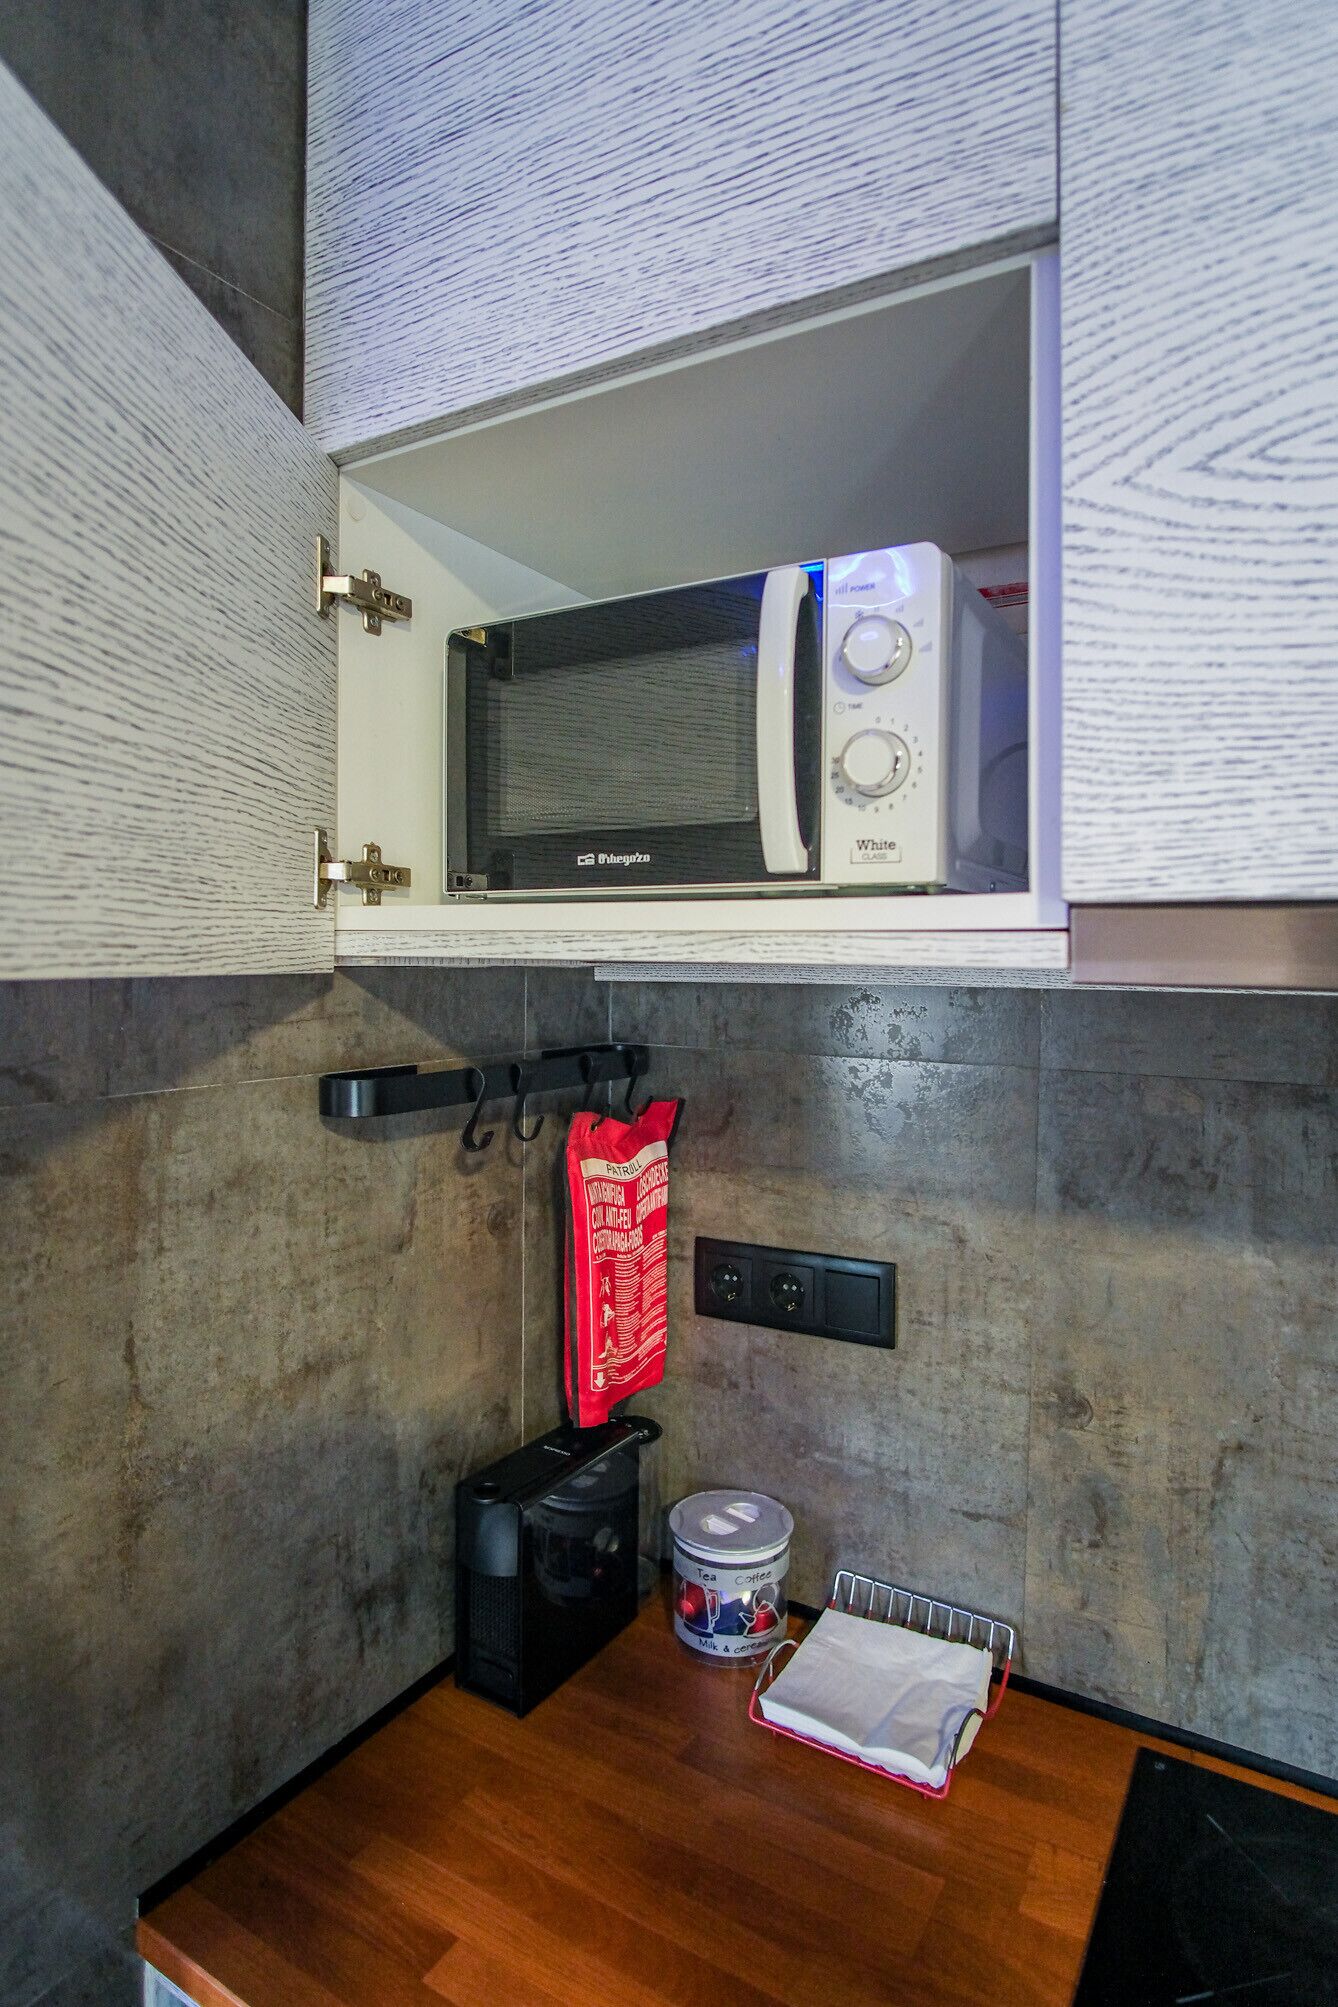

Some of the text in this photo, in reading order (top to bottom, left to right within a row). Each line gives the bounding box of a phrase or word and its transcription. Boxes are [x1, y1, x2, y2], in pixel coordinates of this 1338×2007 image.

[850, 582, 876, 593] POWER
[835, 786, 845, 794] 20
[856, 839, 896, 850] White
[862, 852, 887, 860] CLASS
[697, 1568, 772, 1586] Tea Coffee
[699, 1638, 718, 1651] Milk
[723, 1645, 730, 1653] &
